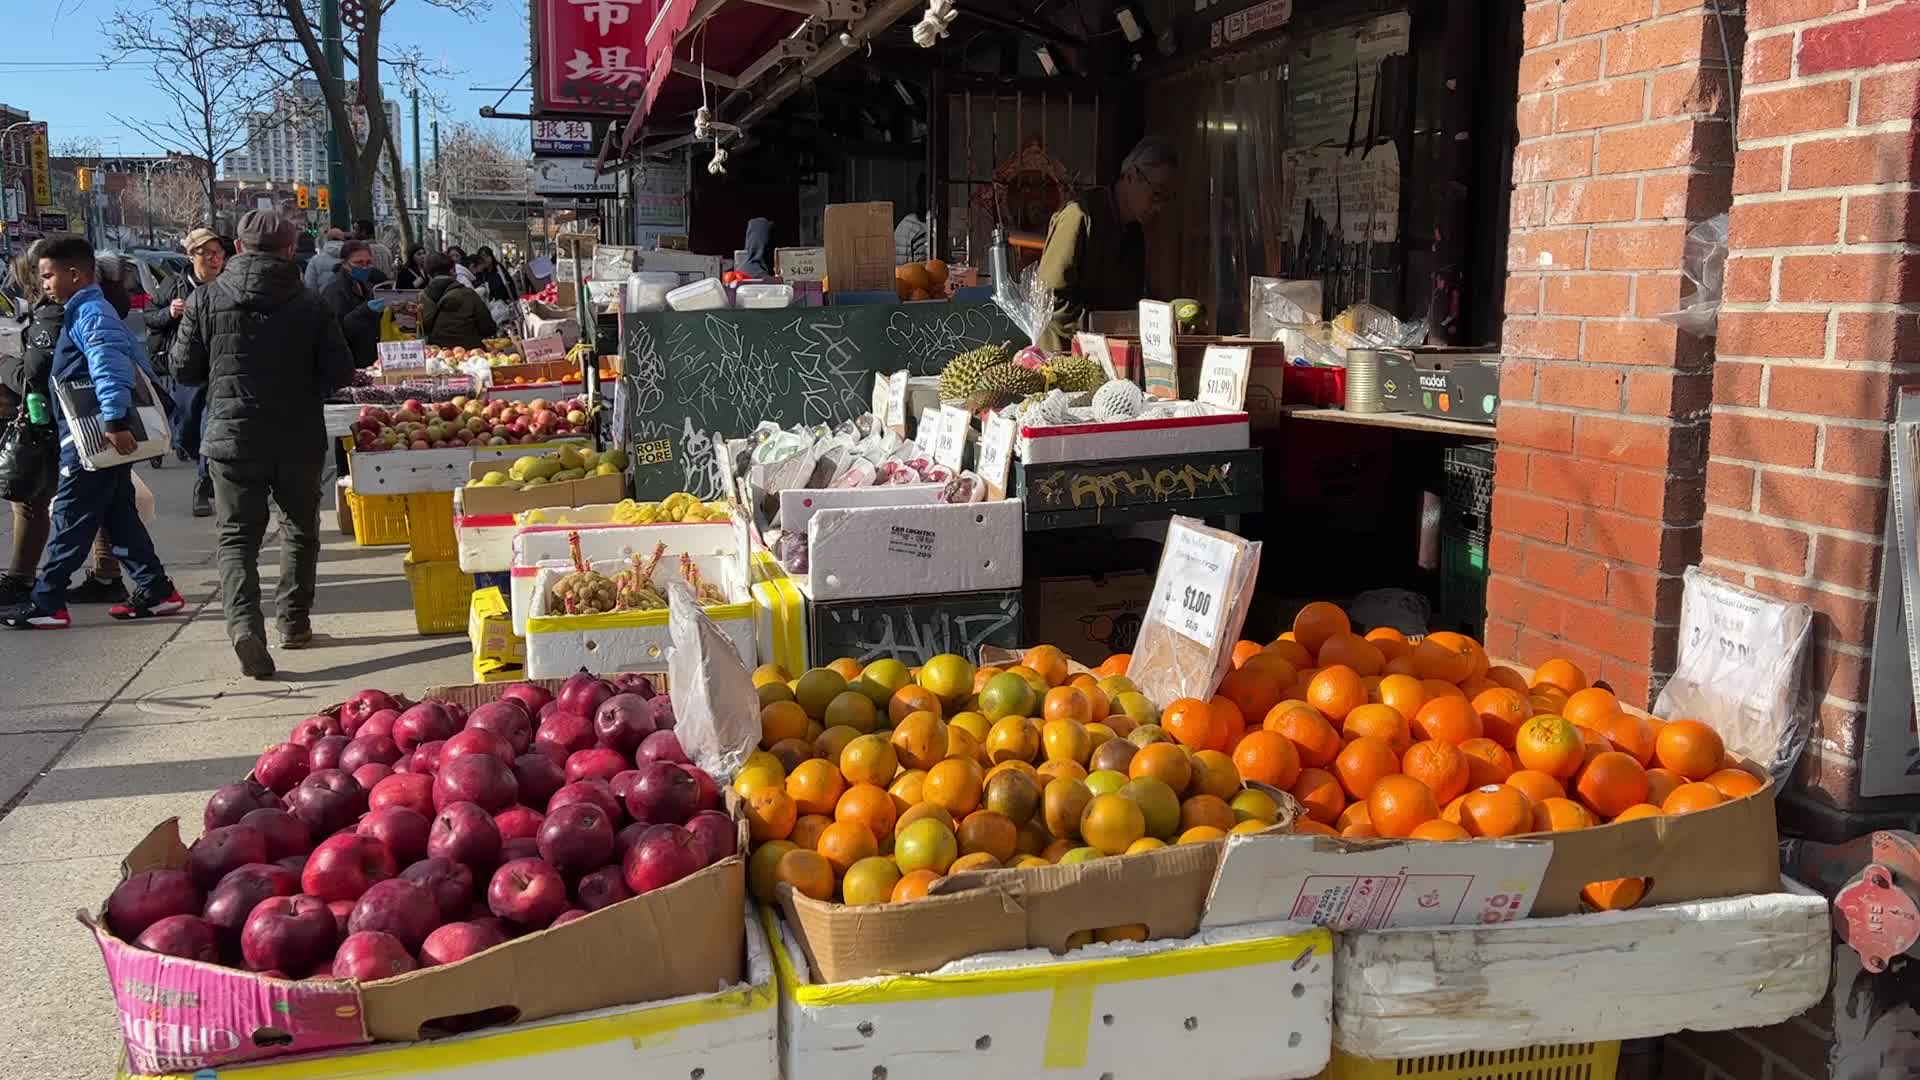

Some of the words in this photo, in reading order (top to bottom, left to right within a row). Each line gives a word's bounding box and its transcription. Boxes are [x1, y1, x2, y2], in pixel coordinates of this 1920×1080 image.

[554, 141, 573, 151] Floor
[790, 266, 814, 276] $4.99
[1144, 332, 1161, 347] $4.99
[636, 440, 669, 454] ROBE
[639, 450, 672, 464] FORE
[1182, 585, 1211, 617] $1.00
